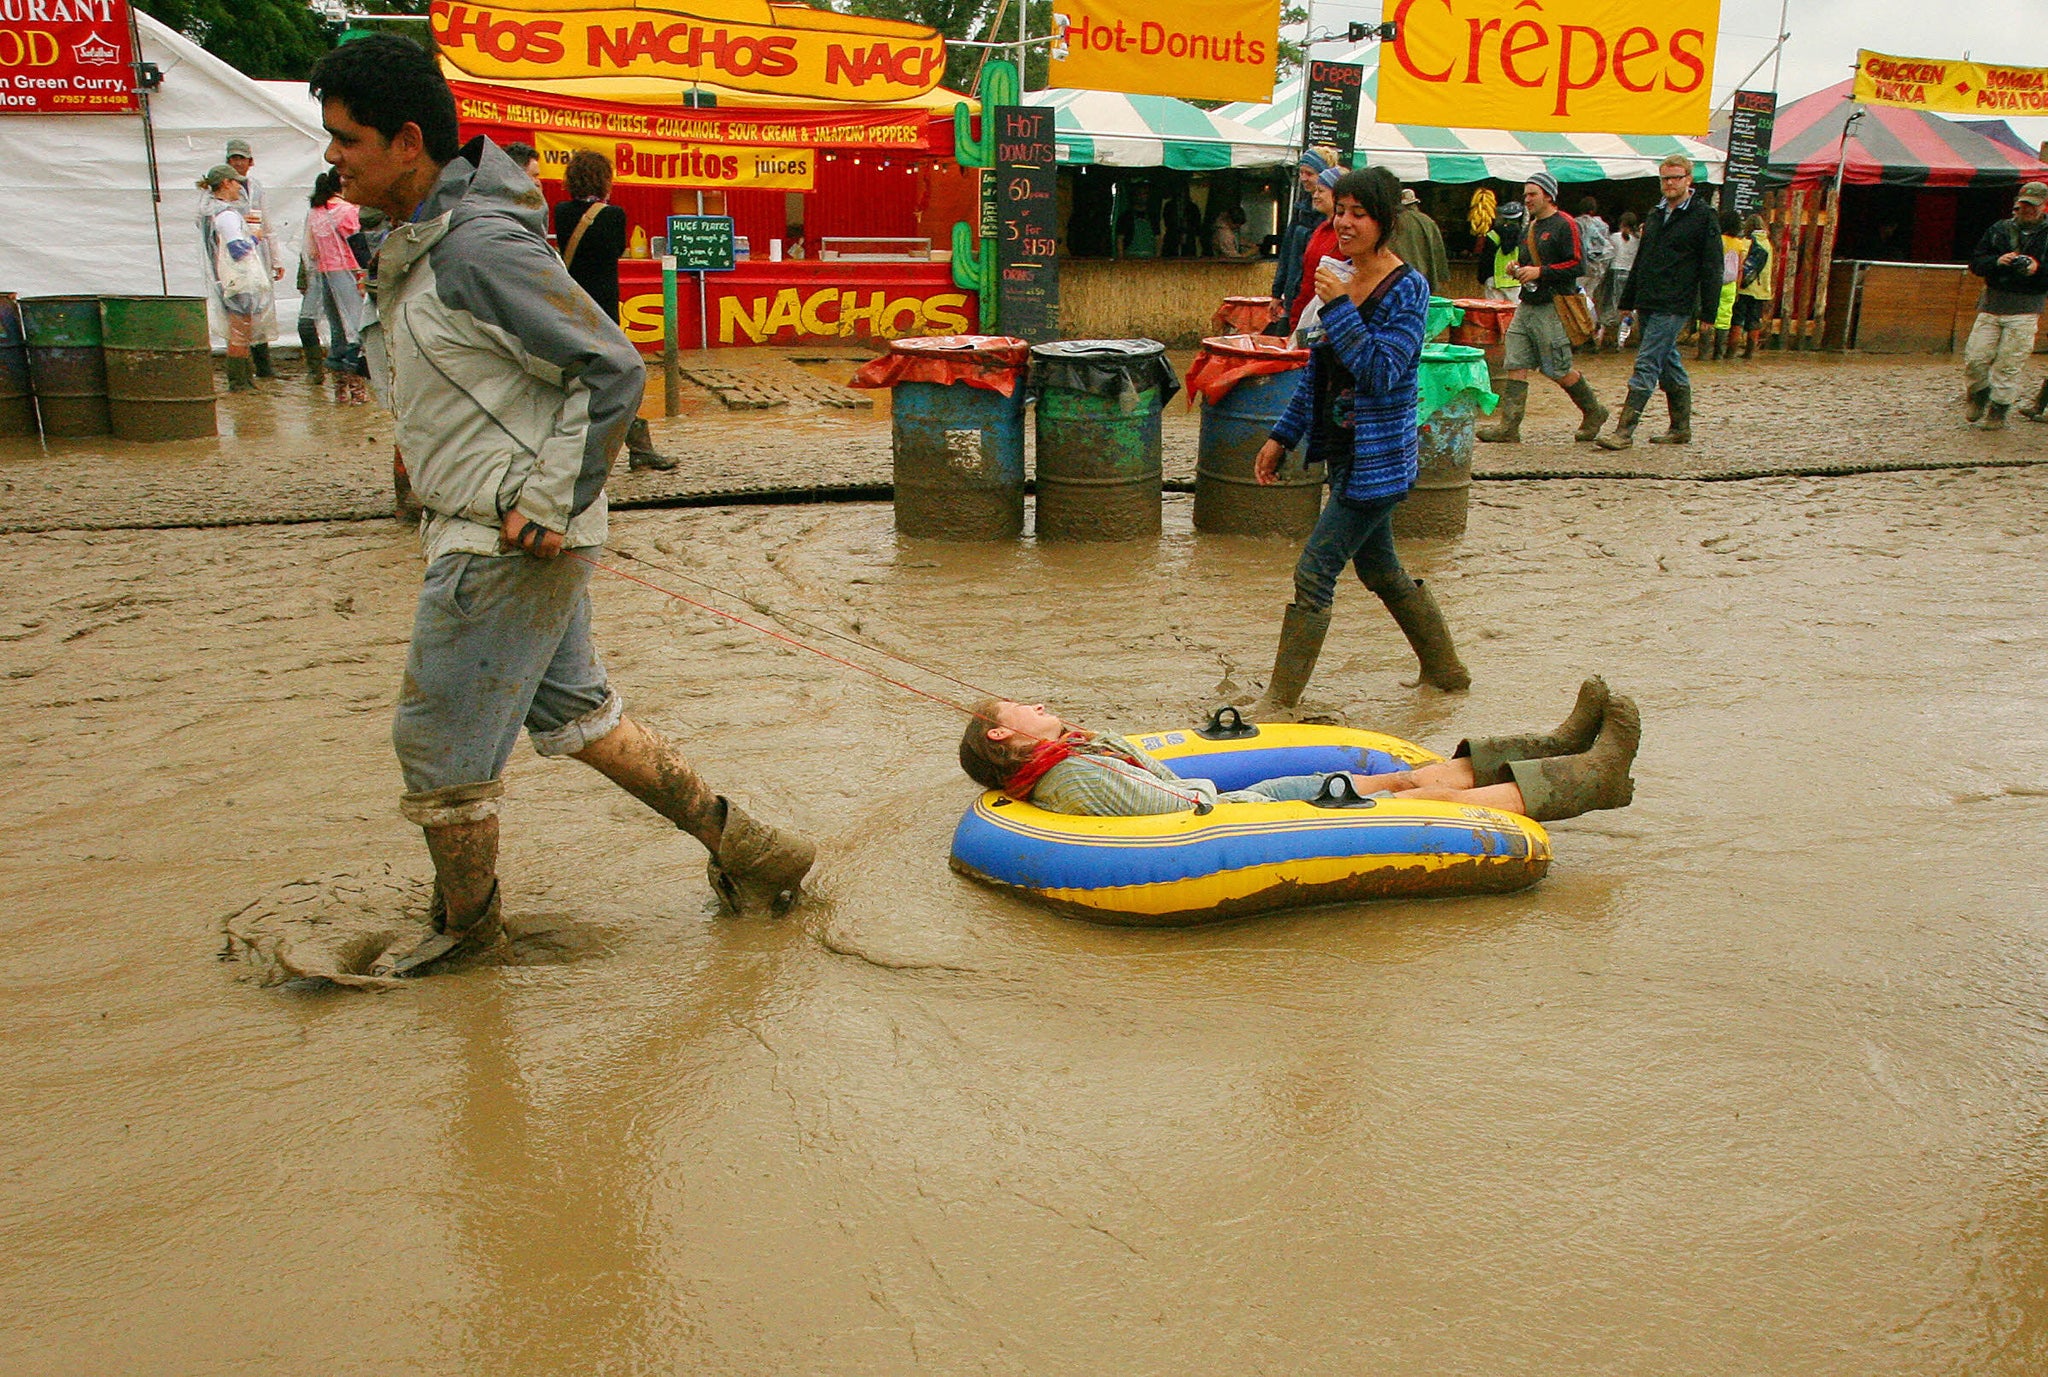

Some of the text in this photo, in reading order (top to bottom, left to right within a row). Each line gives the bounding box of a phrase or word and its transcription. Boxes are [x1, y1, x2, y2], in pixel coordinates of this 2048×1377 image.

[587, 21, 799, 77] NACHOS
[1064, 14, 1265, 65] Hot-Donuts
[1393, 0, 1705, 117] Crêpes
[1865, 58, 1946, 84] CHICKEN
[1987, 70, 2048, 91] BOMBA
[14, 75, 68, 89] Green
[73, 76, 127, 92] Curry,
[1875, 80, 1927, 104] TIKKA
[53, 95, 86, 104] 07957
[89, 95, 128, 104] 251498
[461, 100, 502, 122] SALSA,
[506, 104, 603, 130] MELTED/GRATED
[606, 115, 652, 136] CHEESE,
[656, 117, 724, 142] GUACAMOLE,
[728, 122, 758, 141] SOUR
[761, 125, 798, 143] CREAM
[800, 127, 809, 141] &
[868, 125, 918, 143] PEPPERS
[615, 142, 738, 180] Burritos
[755, 154, 807, 178] juices
[999, 143, 1054, 162] DONUTS
[1009, 178, 1031, 201] 60
[673, 220, 730, 232] HUGE PLATES
[1005, 220, 1019, 241] 3
[618, 288, 970, 345] S NACHOS
